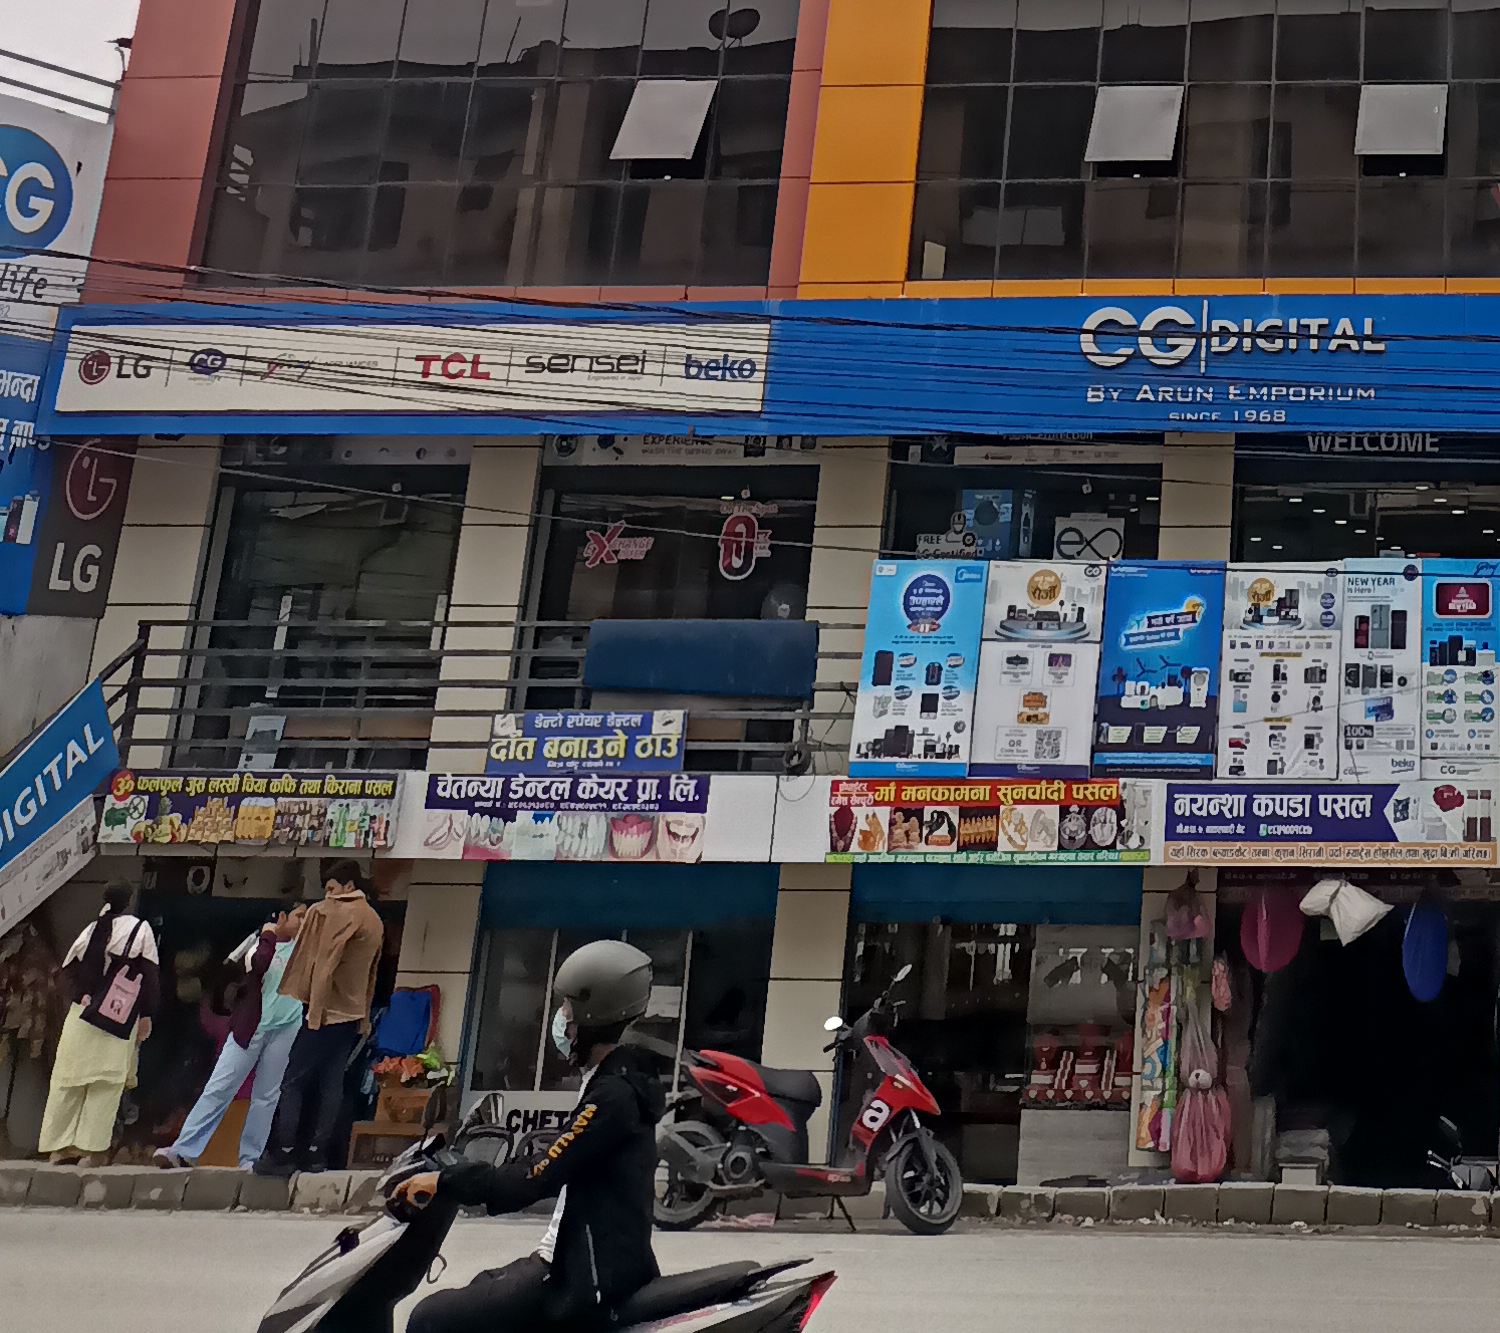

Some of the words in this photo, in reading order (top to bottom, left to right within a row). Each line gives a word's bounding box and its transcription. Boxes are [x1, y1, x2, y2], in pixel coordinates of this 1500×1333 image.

[0, 151, 55, 234] G
[1079, 305, 1197, 367] CG
[1210, 316, 1386, 353] DIGITAL
[116, 355, 152, 379] LG
[193, 353, 222, 369] CG
[415, 352, 491, 380] TCL
[524, 349, 648, 375] sensei
[684, 354, 757, 381] beko
[1086, 384, 1121, 404] BY
[1135, 383, 1214, 403] ARUN
[1228, 384, 1376, 402] EMPORIUM
[1232, 409, 1287, 422] 1968
[1307, 432, 1440, 453] WELCOME
[48, 542, 102, 593] LG
[1347, 577, 1370, 586] NEW
[1371, 577, 1395, 586] YEAR
[543, 728, 629, 759] बनाउने
[0, 723, 105, 849] IGITAL
[508, 772, 574, 801] डेन्टल
[576, 772, 633, 801] केयर
[636, 776, 663, 804] प्रा.
[669, 773, 700, 802] लि.
[901, 784, 992, 803] मनकामना
[1072, 784, 1120, 803] पसल
[1252, 794, 1313, 819] कपडा
[1317, 794, 1374, 820] पसल
